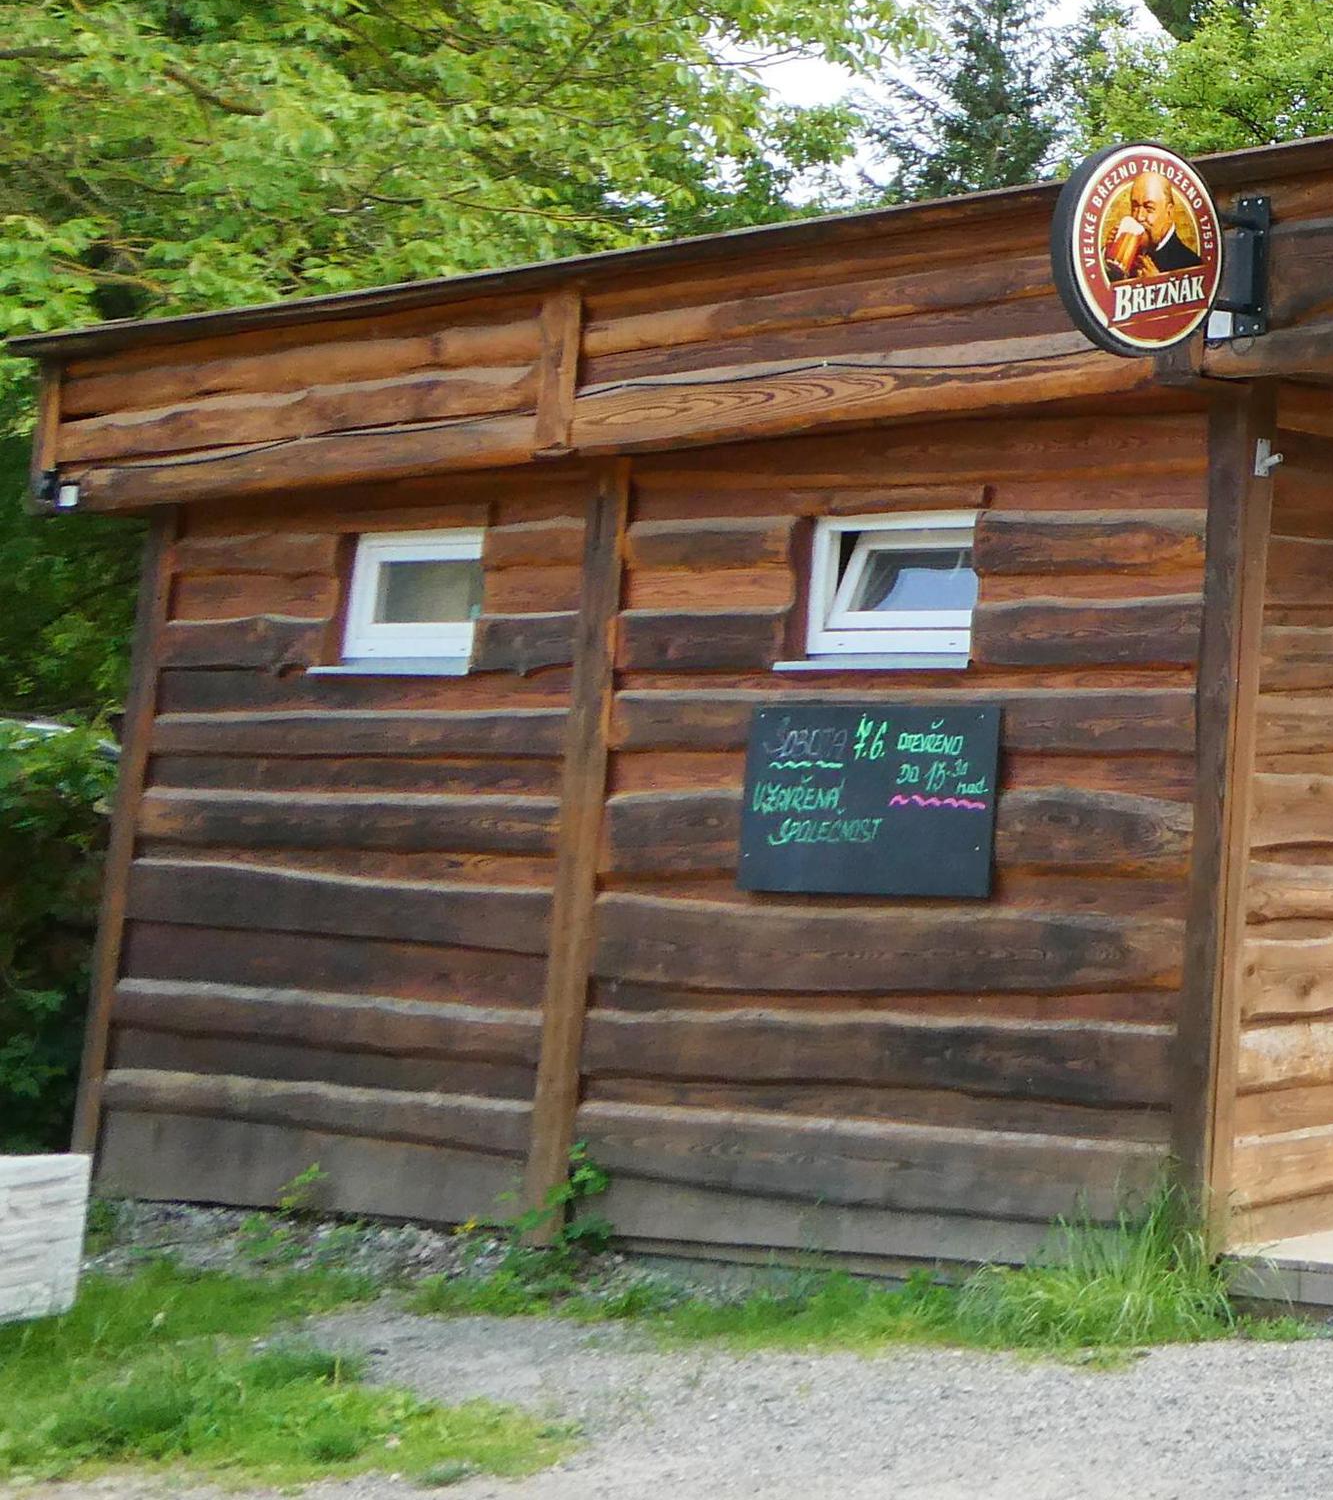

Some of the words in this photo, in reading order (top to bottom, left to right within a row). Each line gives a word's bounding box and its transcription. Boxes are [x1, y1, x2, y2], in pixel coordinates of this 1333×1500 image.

[1084, 212, 1097, 268] VELKÉ
[1092, 161, 1137, 207] BŘEZNO
[1142, 159, 1202, 209] ZALOŽENO
[1199, 215, 1213, 249] 1753
[1112, 274, 1205, 322] BŘEZŇÁK
